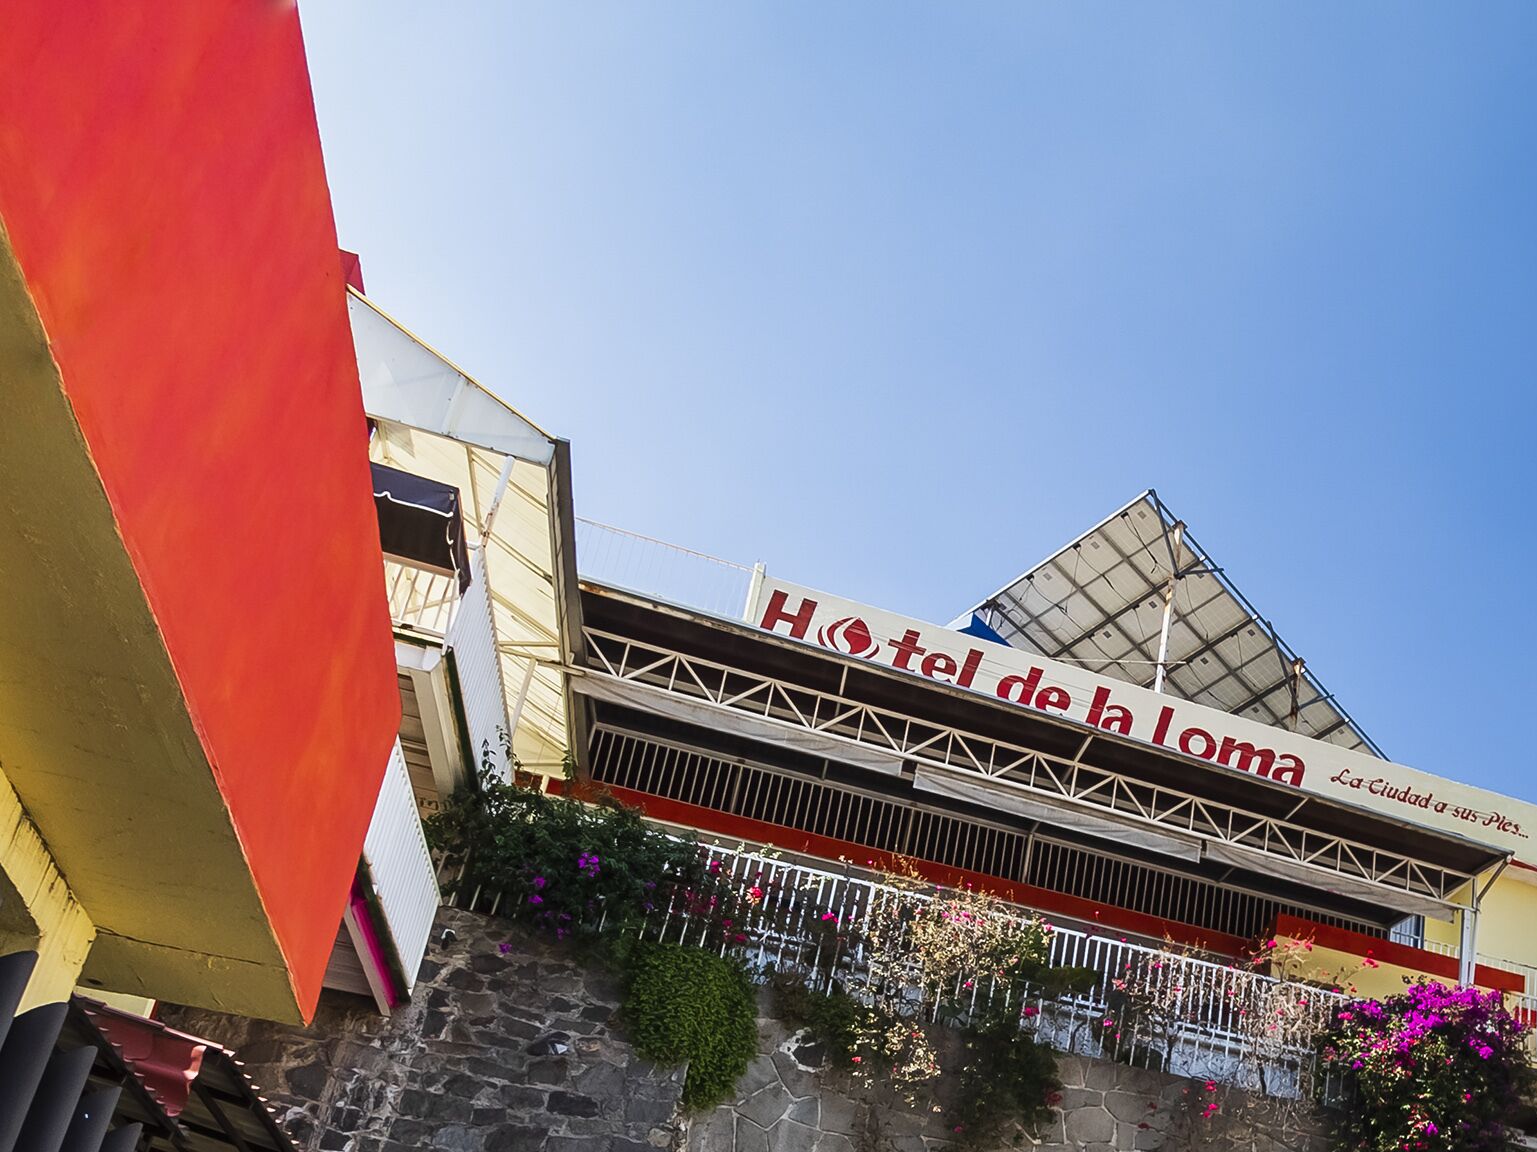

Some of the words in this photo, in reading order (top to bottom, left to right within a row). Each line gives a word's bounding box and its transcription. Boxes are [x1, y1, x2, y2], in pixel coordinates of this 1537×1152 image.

[996, 666, 1071, 711] de
[1085, 686, 1133, 736] la
[1330, 768, 1363, 789] La
[1368, 778, 1433, 809] Ciudad
[1434, 801, 1448, 814] a
[1451, 806, 1479, 823] sus
